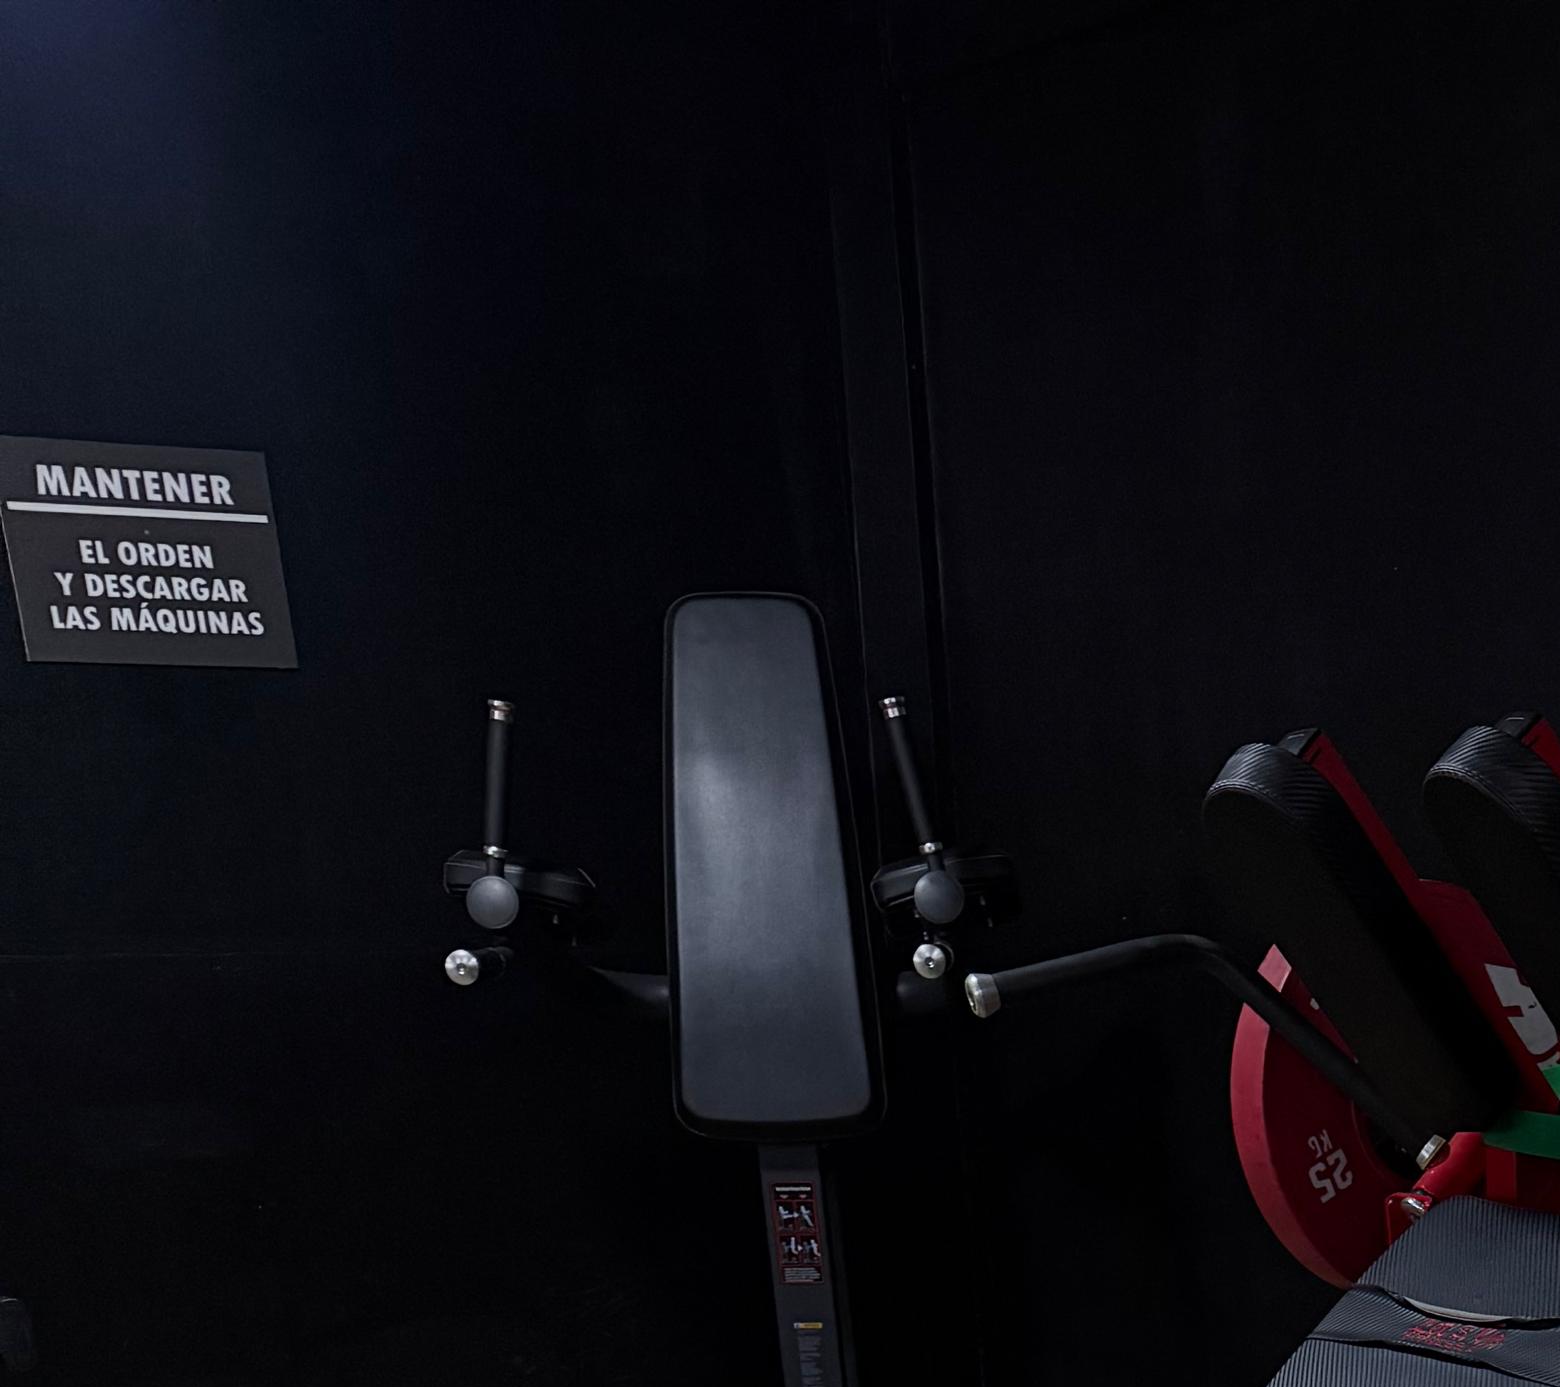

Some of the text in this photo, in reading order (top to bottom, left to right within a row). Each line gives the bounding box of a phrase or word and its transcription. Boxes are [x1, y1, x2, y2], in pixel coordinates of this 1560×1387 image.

[35, 463, 235, 506] MANTENER
[78, 539, 215, 569] EL ORDEN
[53, 572, 249, 603] Y DESCARGAR
[50, 602, 265, 636] LAS MÁQUINAS
[1306, 1128, 1354, 1204] 25 KG
